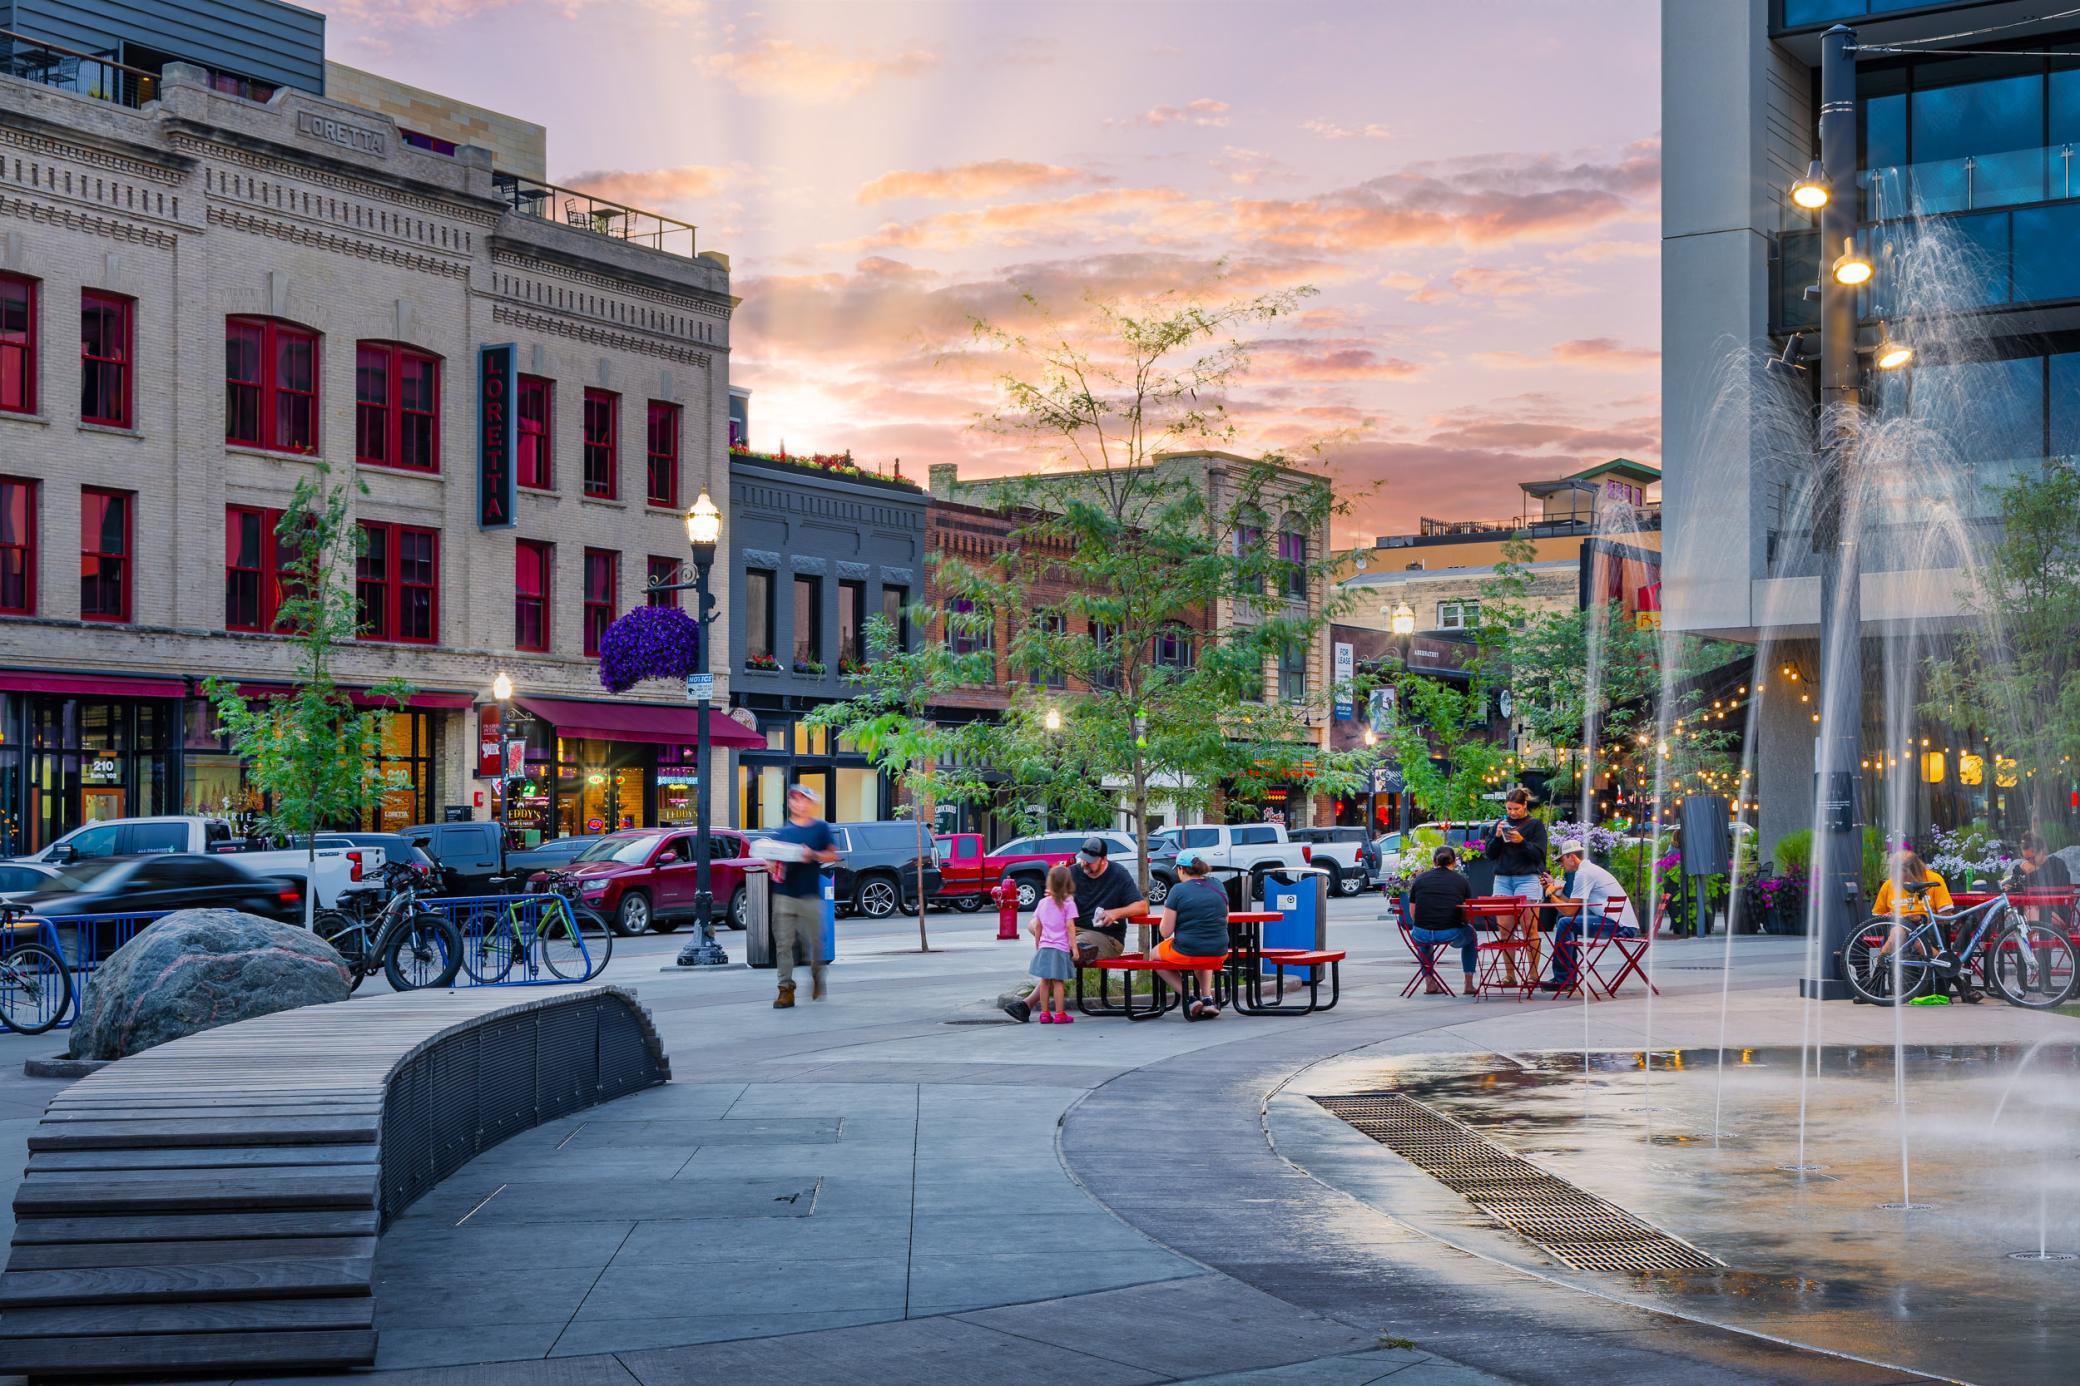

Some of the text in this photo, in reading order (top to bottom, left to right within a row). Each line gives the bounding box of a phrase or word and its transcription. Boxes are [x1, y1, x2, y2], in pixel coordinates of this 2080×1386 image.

[298, 113, 383, 154] LORETTA
[485, 354, 503, 519] LORETTA
[1339, 648, 1349, 656] FOR
[1337, 657, 1351, 665] LEASE
[688, 675, 712, 683] NOTICE
[94, 760, 113, 771] 210
[387, 769, 408, 781] 210
[508, 809, 541, 820] EDDY'S
